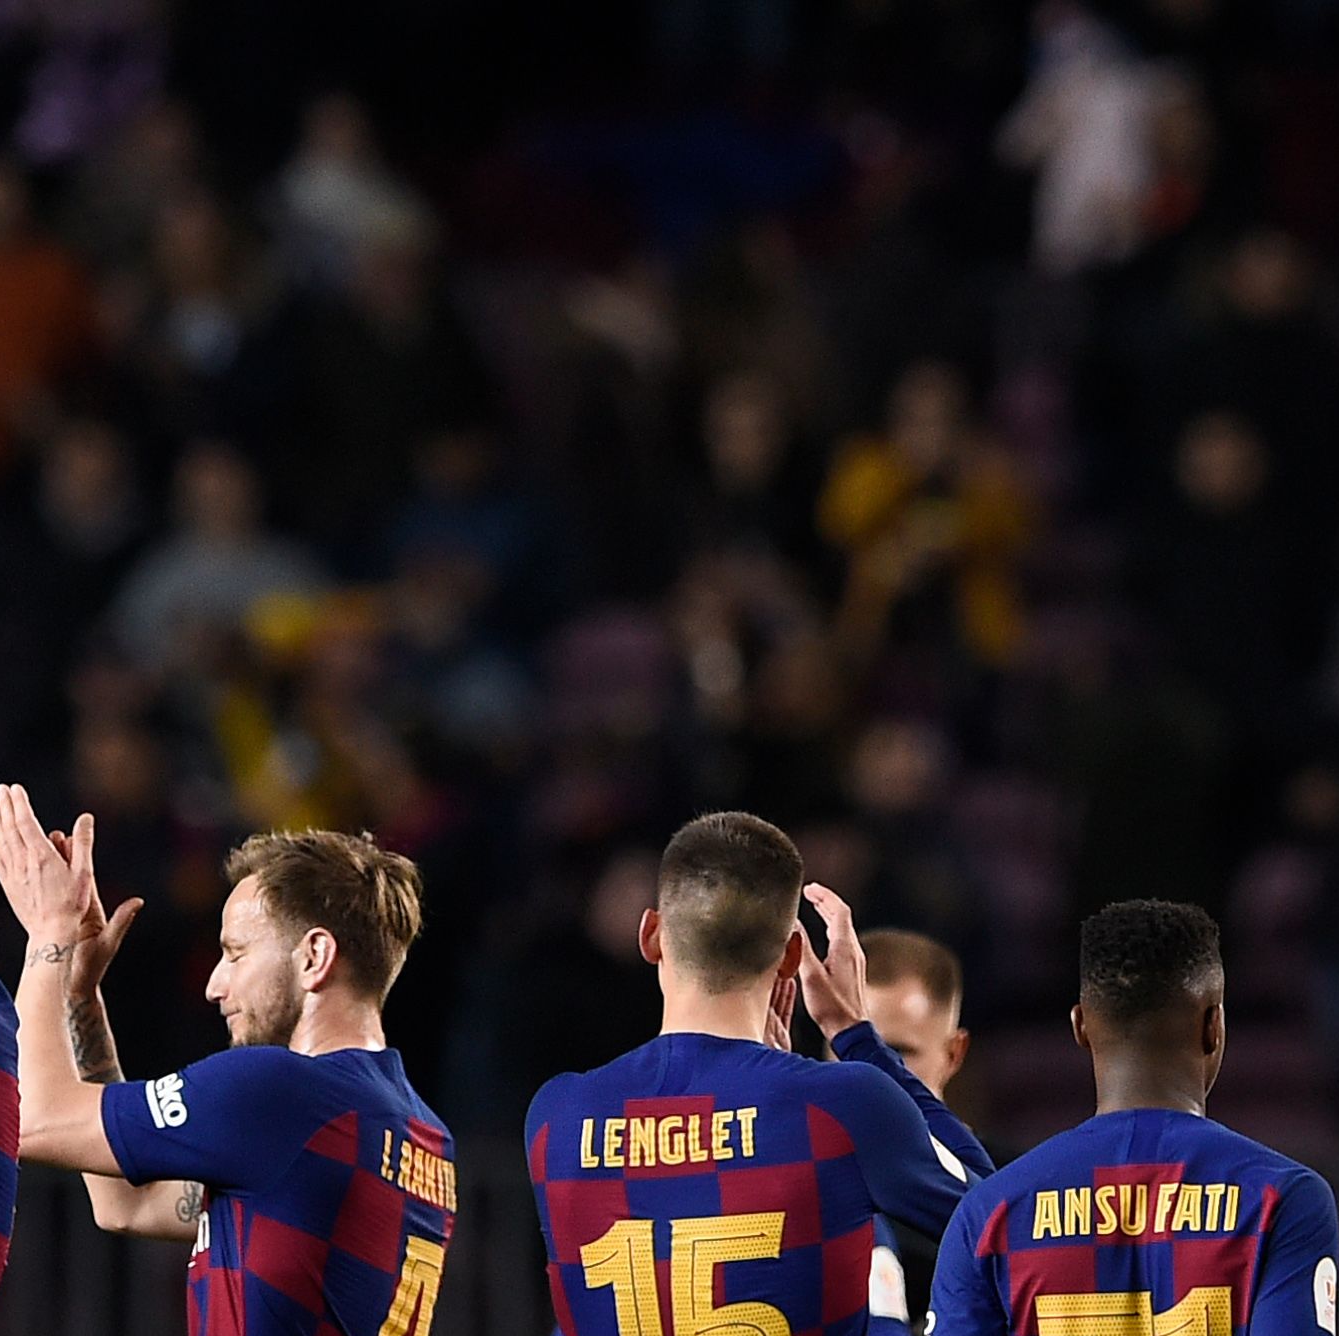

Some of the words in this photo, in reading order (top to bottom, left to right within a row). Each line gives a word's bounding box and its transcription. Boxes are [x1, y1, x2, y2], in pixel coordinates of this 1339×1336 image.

[579, 1105, 759, 1169] LENGLET
[1032, 1183, 1149, 1241] ANSU
[1153, 1182, 1241, 1235] FATI
